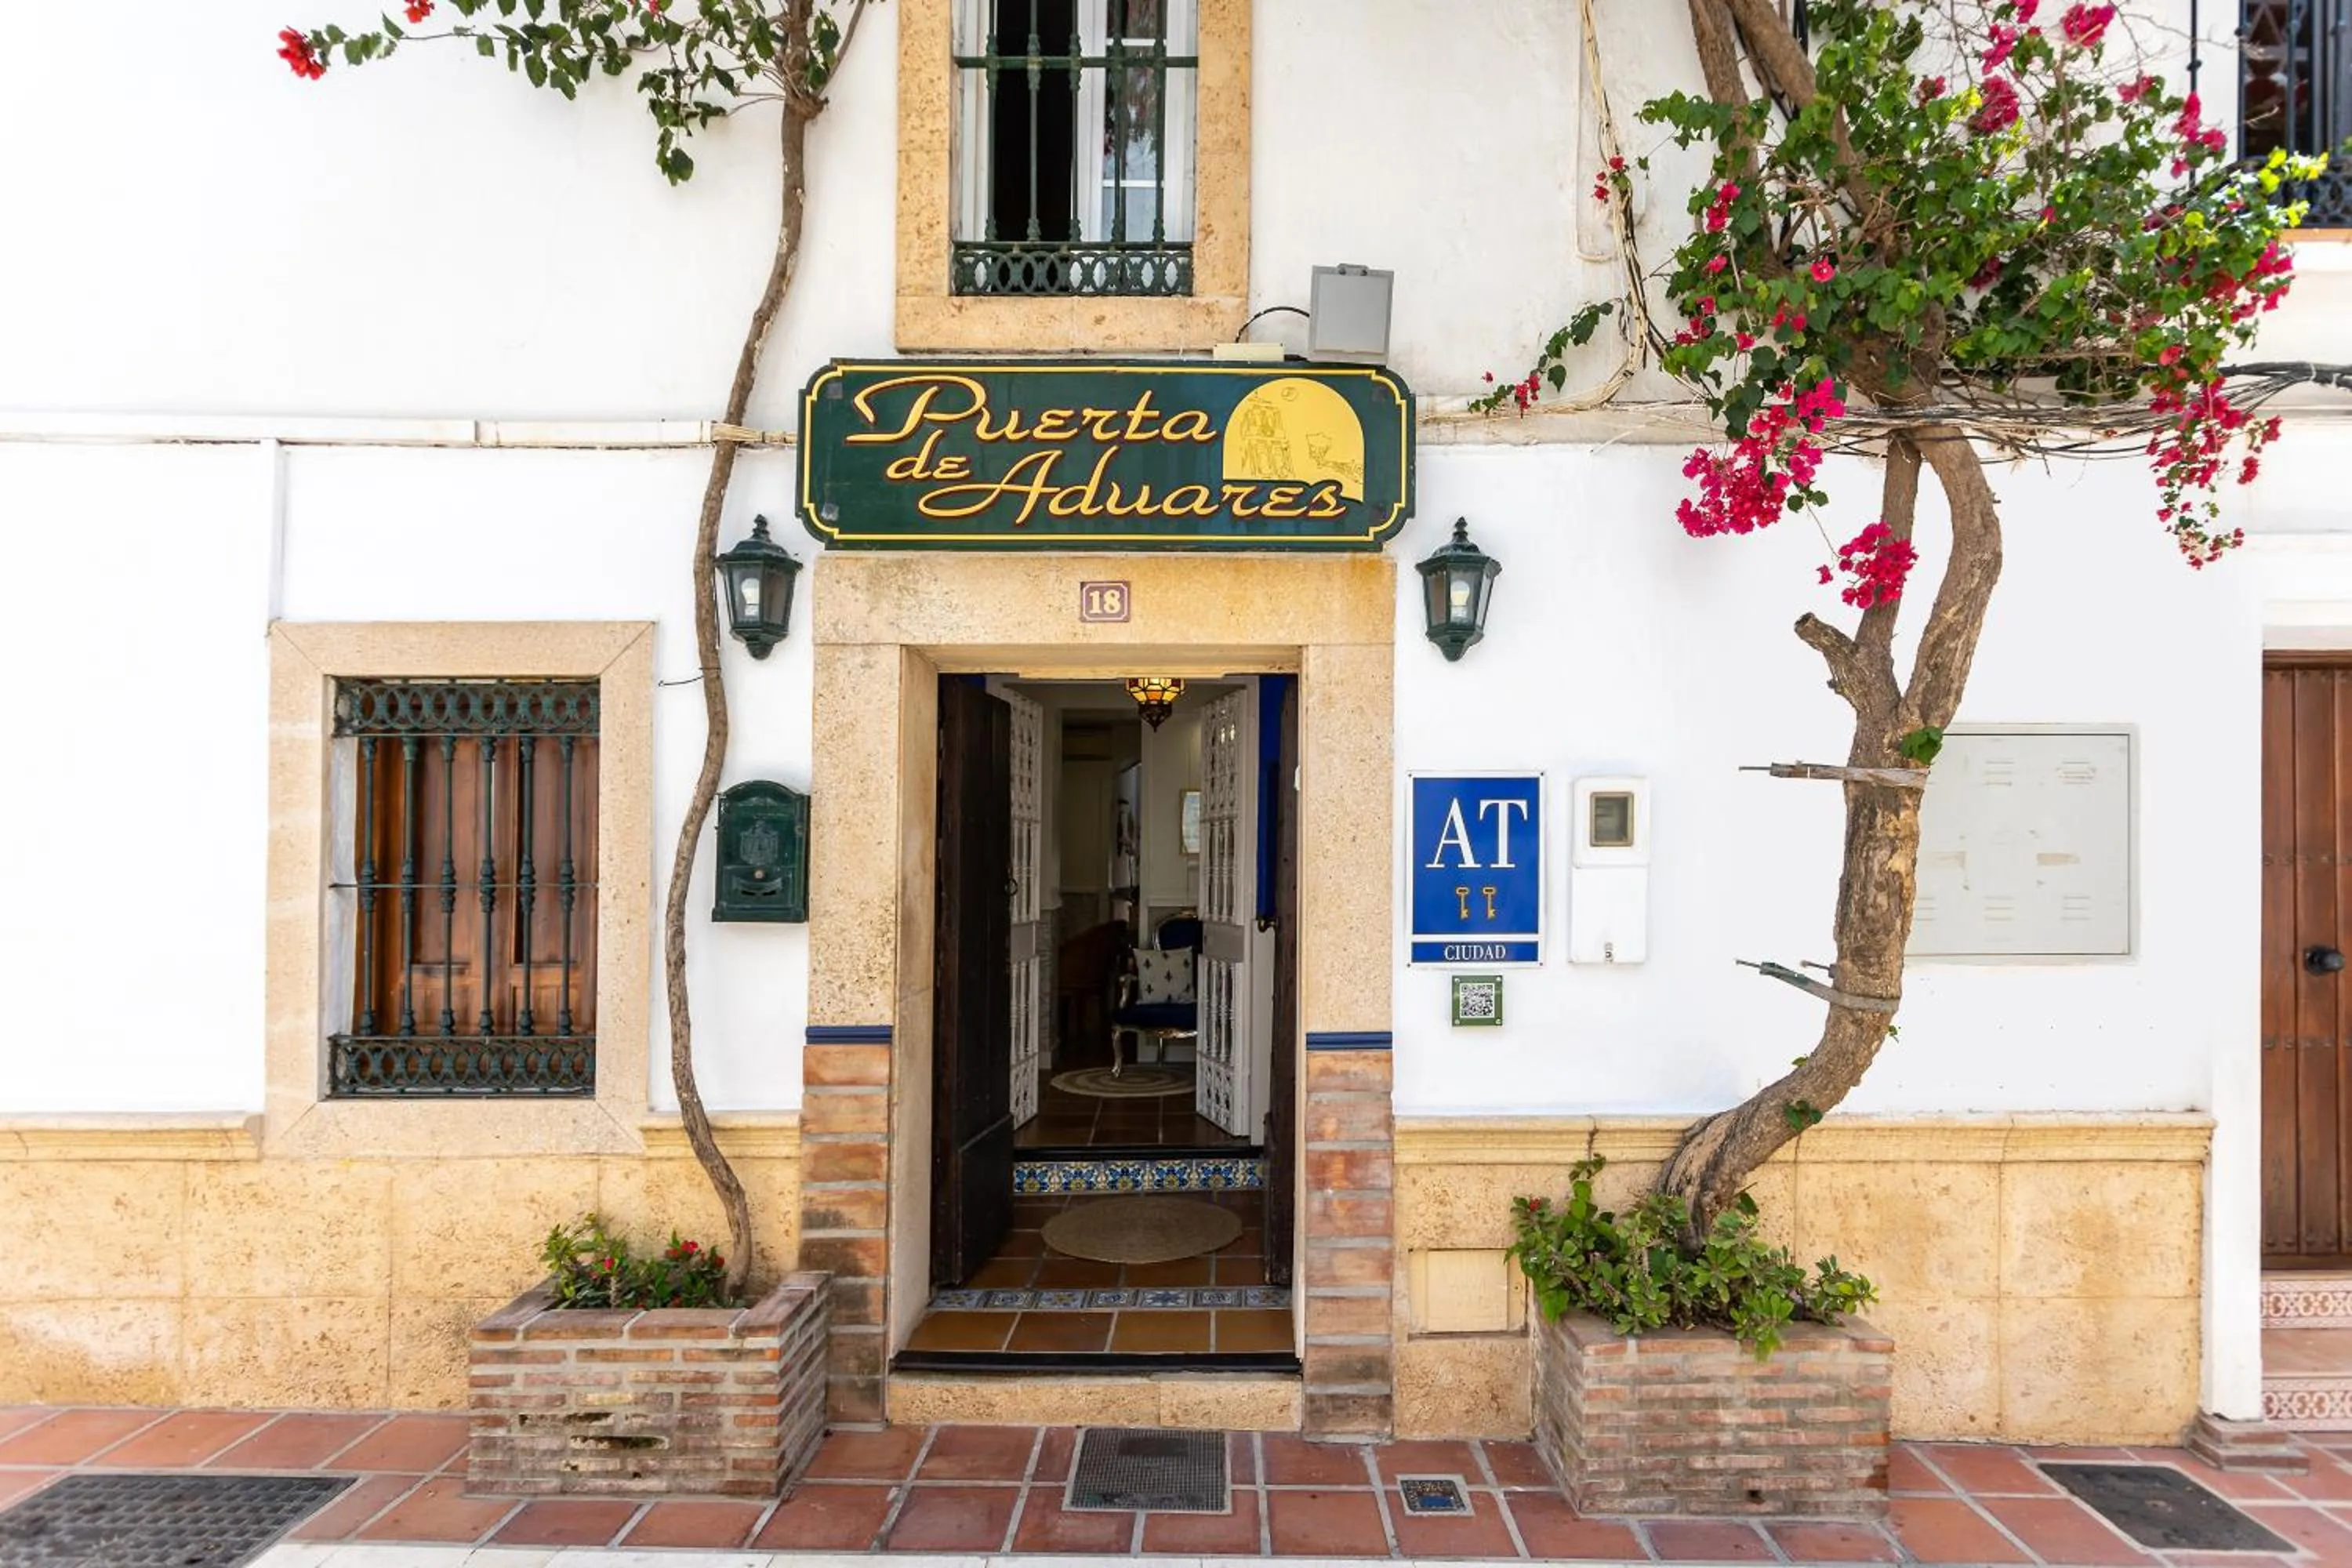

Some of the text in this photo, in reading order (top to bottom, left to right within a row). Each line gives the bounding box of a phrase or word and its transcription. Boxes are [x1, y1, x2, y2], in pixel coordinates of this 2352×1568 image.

[845, 375, 1217, 444] Puerta
[885, 429, 1348, 524] de Aduares
[1089, 589, 1121, 615] 18
[1425, 797, 1528, 869] AT
[1443, 944, 1506, 960] CIUDAD
